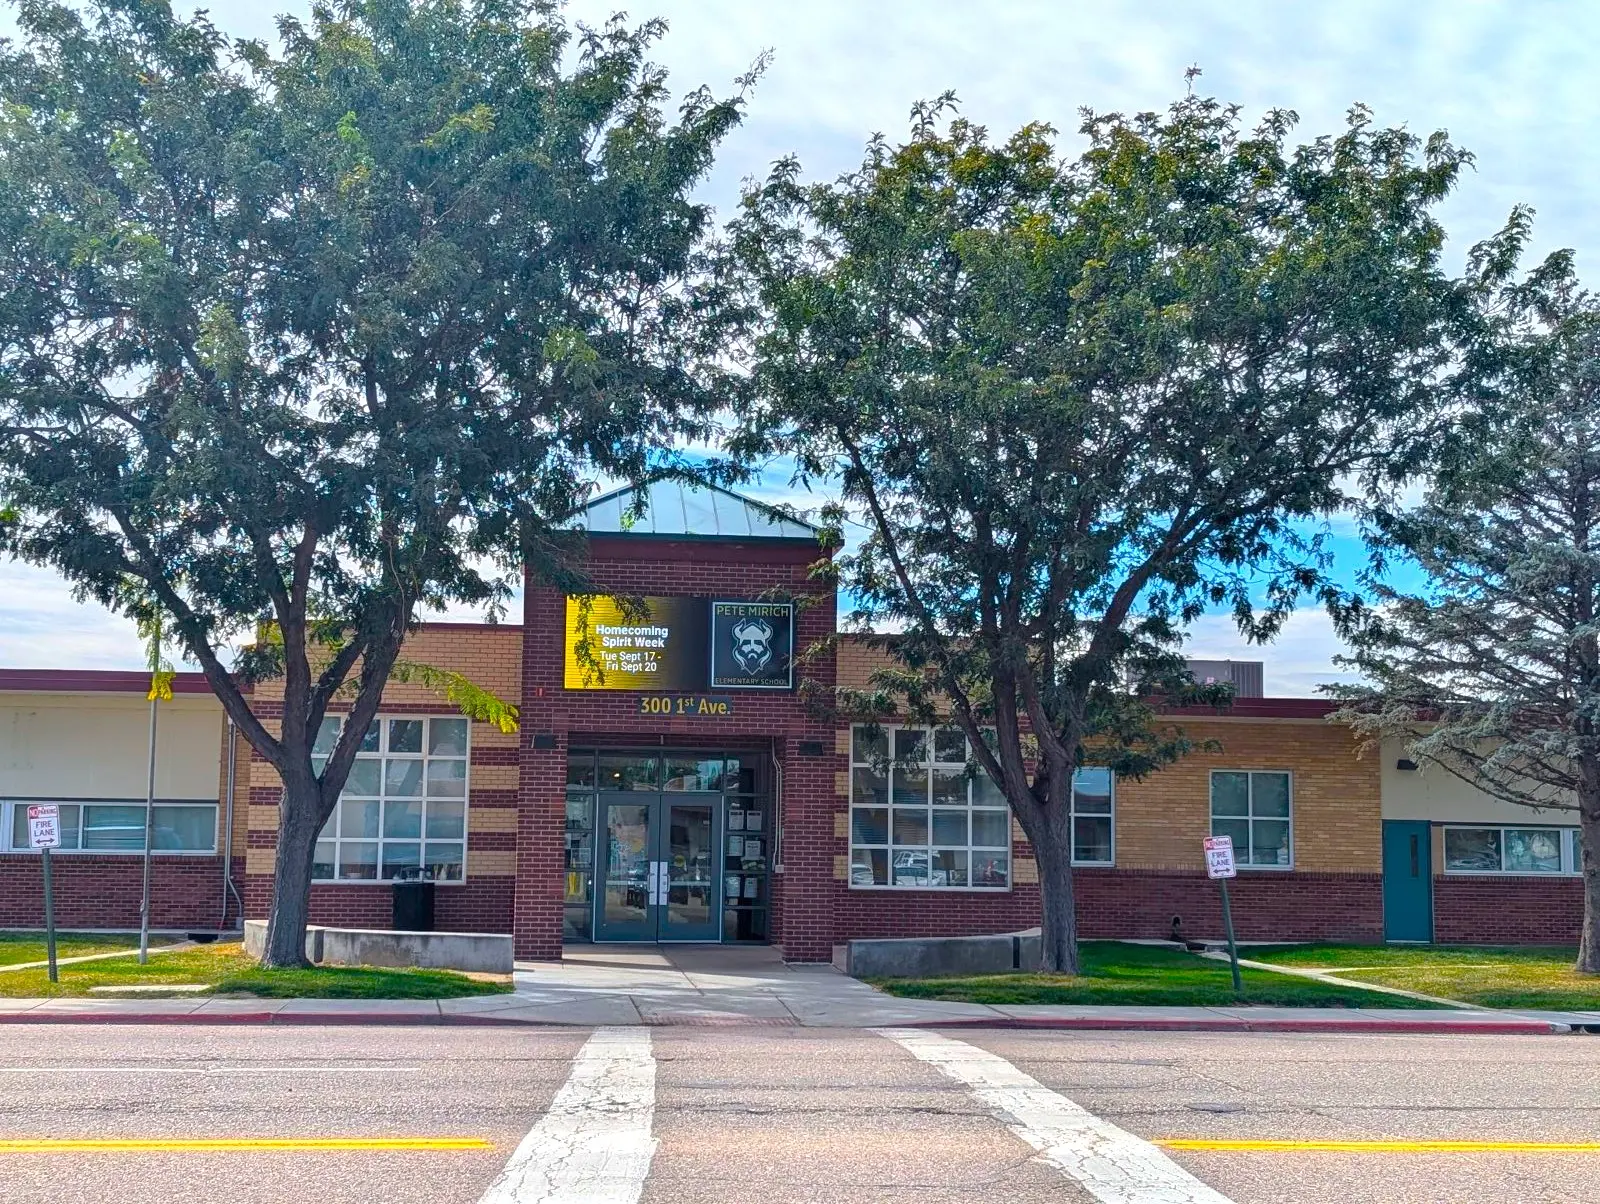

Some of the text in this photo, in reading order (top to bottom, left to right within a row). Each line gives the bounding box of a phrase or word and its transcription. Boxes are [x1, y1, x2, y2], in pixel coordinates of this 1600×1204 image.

[717, 605, 789, 617] PETE MIRICH
[595, 624, 669, 638] Homecoming
[602, 636, 665, 648] Spirit Week
[600, 650, 617, 661] Tue
[619, 651, 641, 663] Sept
[643, 651, 656, 661] 17
[606, 661, 657, 673] Fri Sept 20
[715, 677, 788, 686] ELEMENTARY SCHOOL
[640, 697, 731, 715] 300 1st Ave.
[35, 820, 53, 829] FIRE
[34, 828, 55, 837] LANE
[1211, 851, 1228, 859] FIRE
[1210, 859, 1230, 867] LANE
